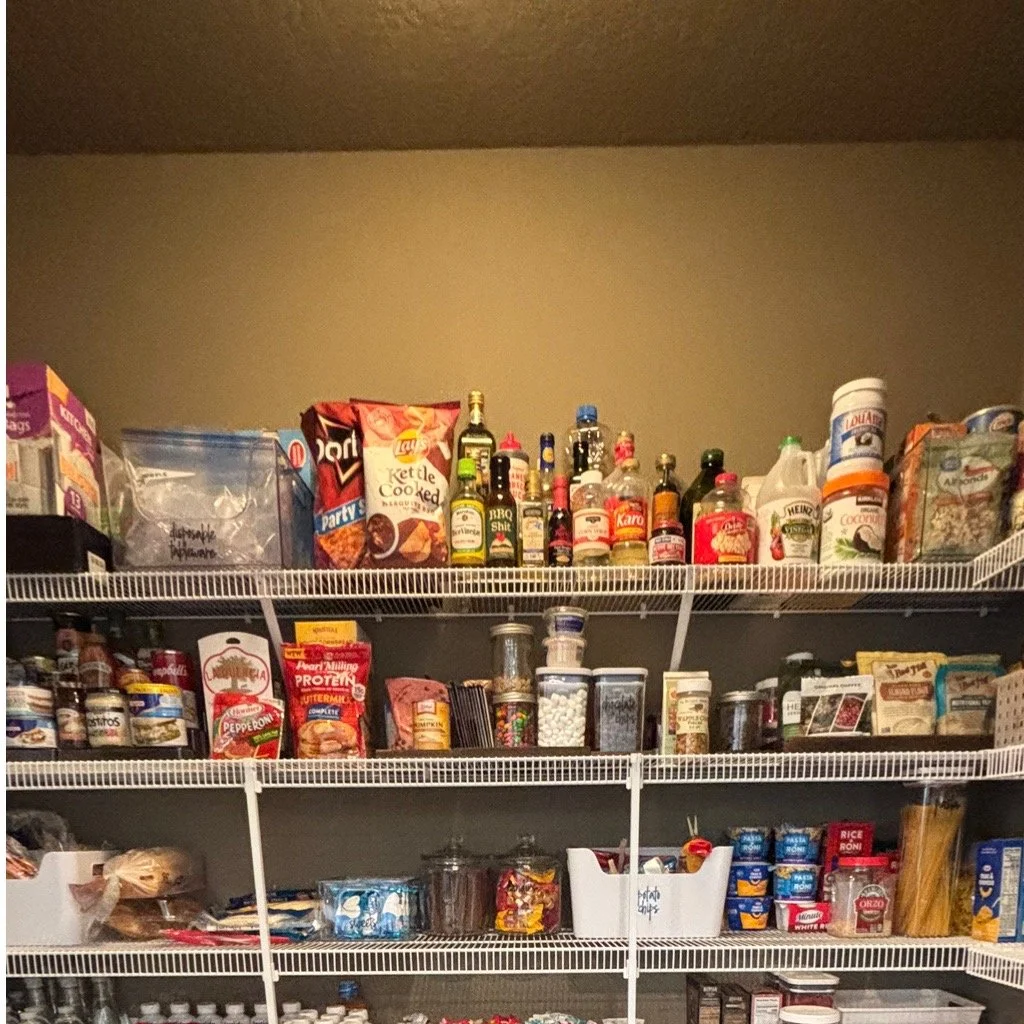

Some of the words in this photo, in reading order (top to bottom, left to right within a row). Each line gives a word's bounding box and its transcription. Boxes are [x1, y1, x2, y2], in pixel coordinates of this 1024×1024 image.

[388, 465, 436, 485] Kettle
[943, 471, 988, 486] Almonds
[379, 481, 441, 507] Cooked
[489, 508, 513, 521] BBQ
[787, 505, 814, 516] HEINZ
[322, 504, 356, 531] Party
[617, 514, 644, 528] Karo
[491, 521, 512, 533] Shit
[296, 661, 323, 671] Pearl
[324, 660, 359, 673] Milling
[295, 673, 356, 688] PROTEIN
[223, 714, 274, 733] PEPPERONI
[840, 830, 863, 839] RICE
[793, 873, 813, 881] PASTA
[859, 900, 884, 909] ORZO
